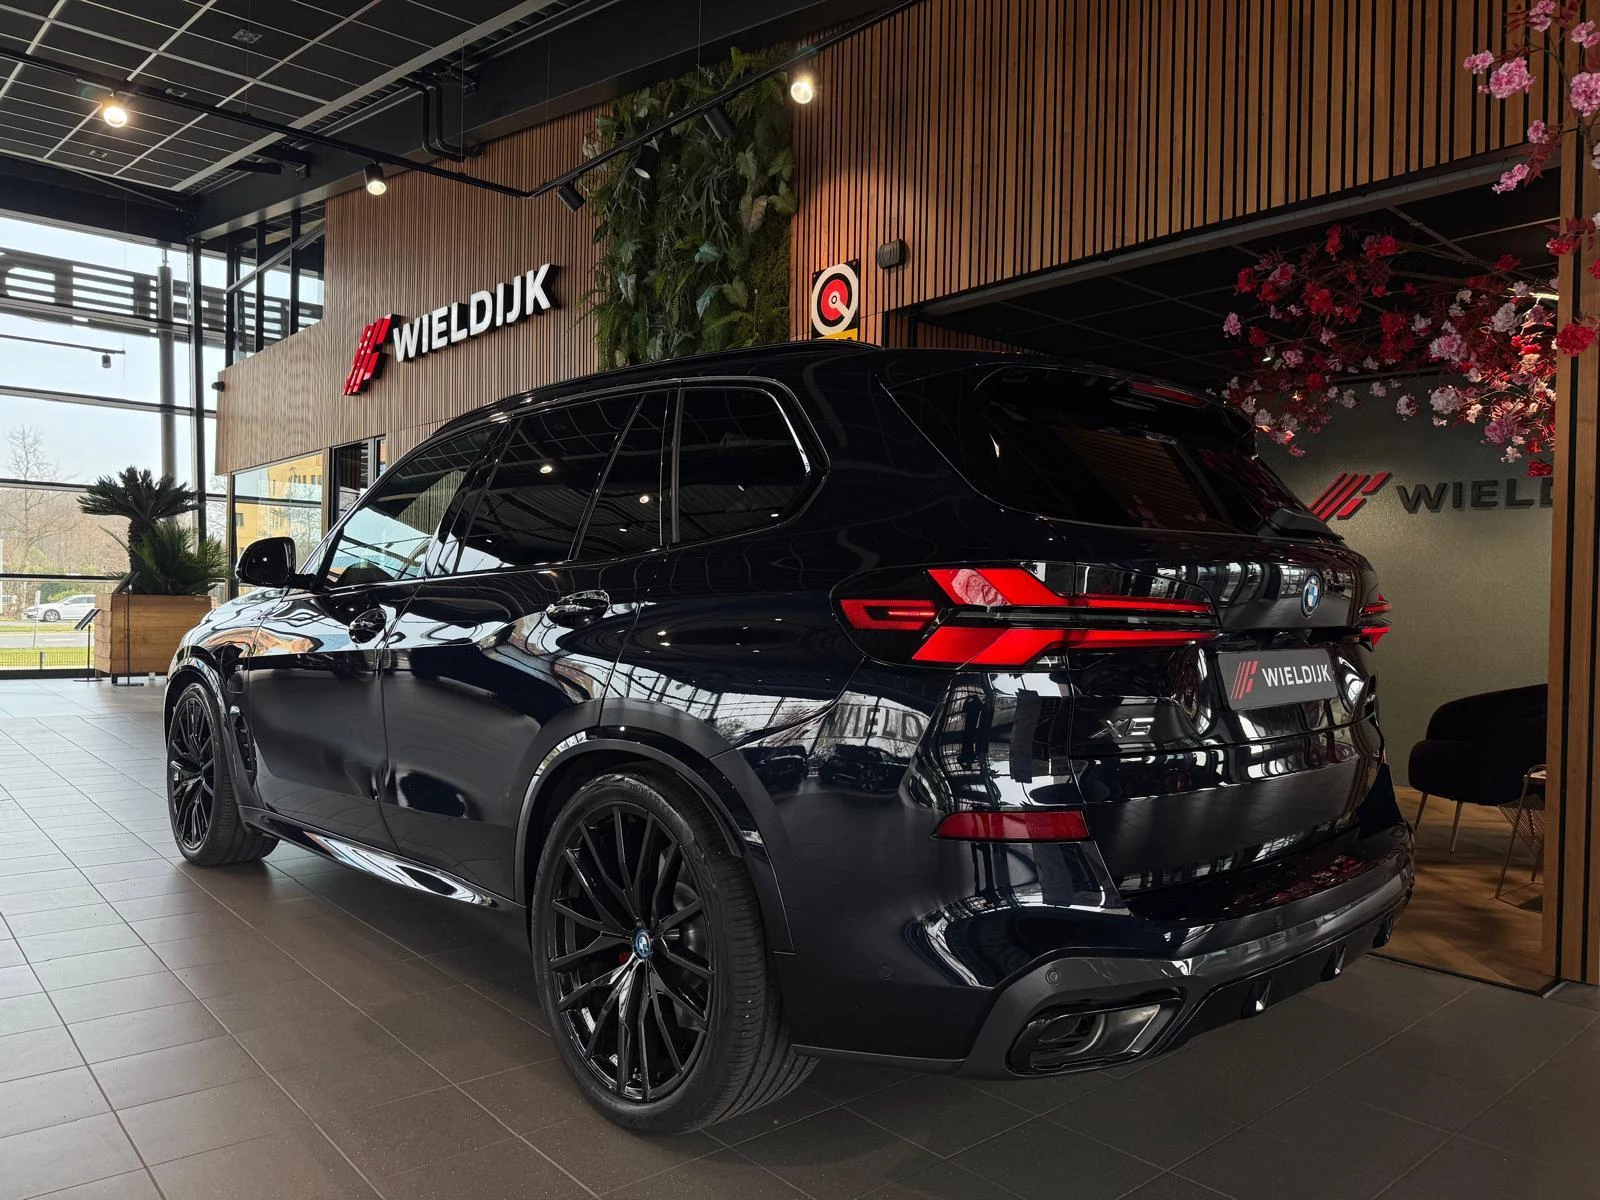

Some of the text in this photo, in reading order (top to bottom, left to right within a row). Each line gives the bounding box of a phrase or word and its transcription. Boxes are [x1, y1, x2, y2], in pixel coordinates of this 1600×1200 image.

[393, 263, 554, 363] WIELDIJK
[1261, 664, 1332, 688] WIELDIJK
[1088, 717, 1155, 739] X5
